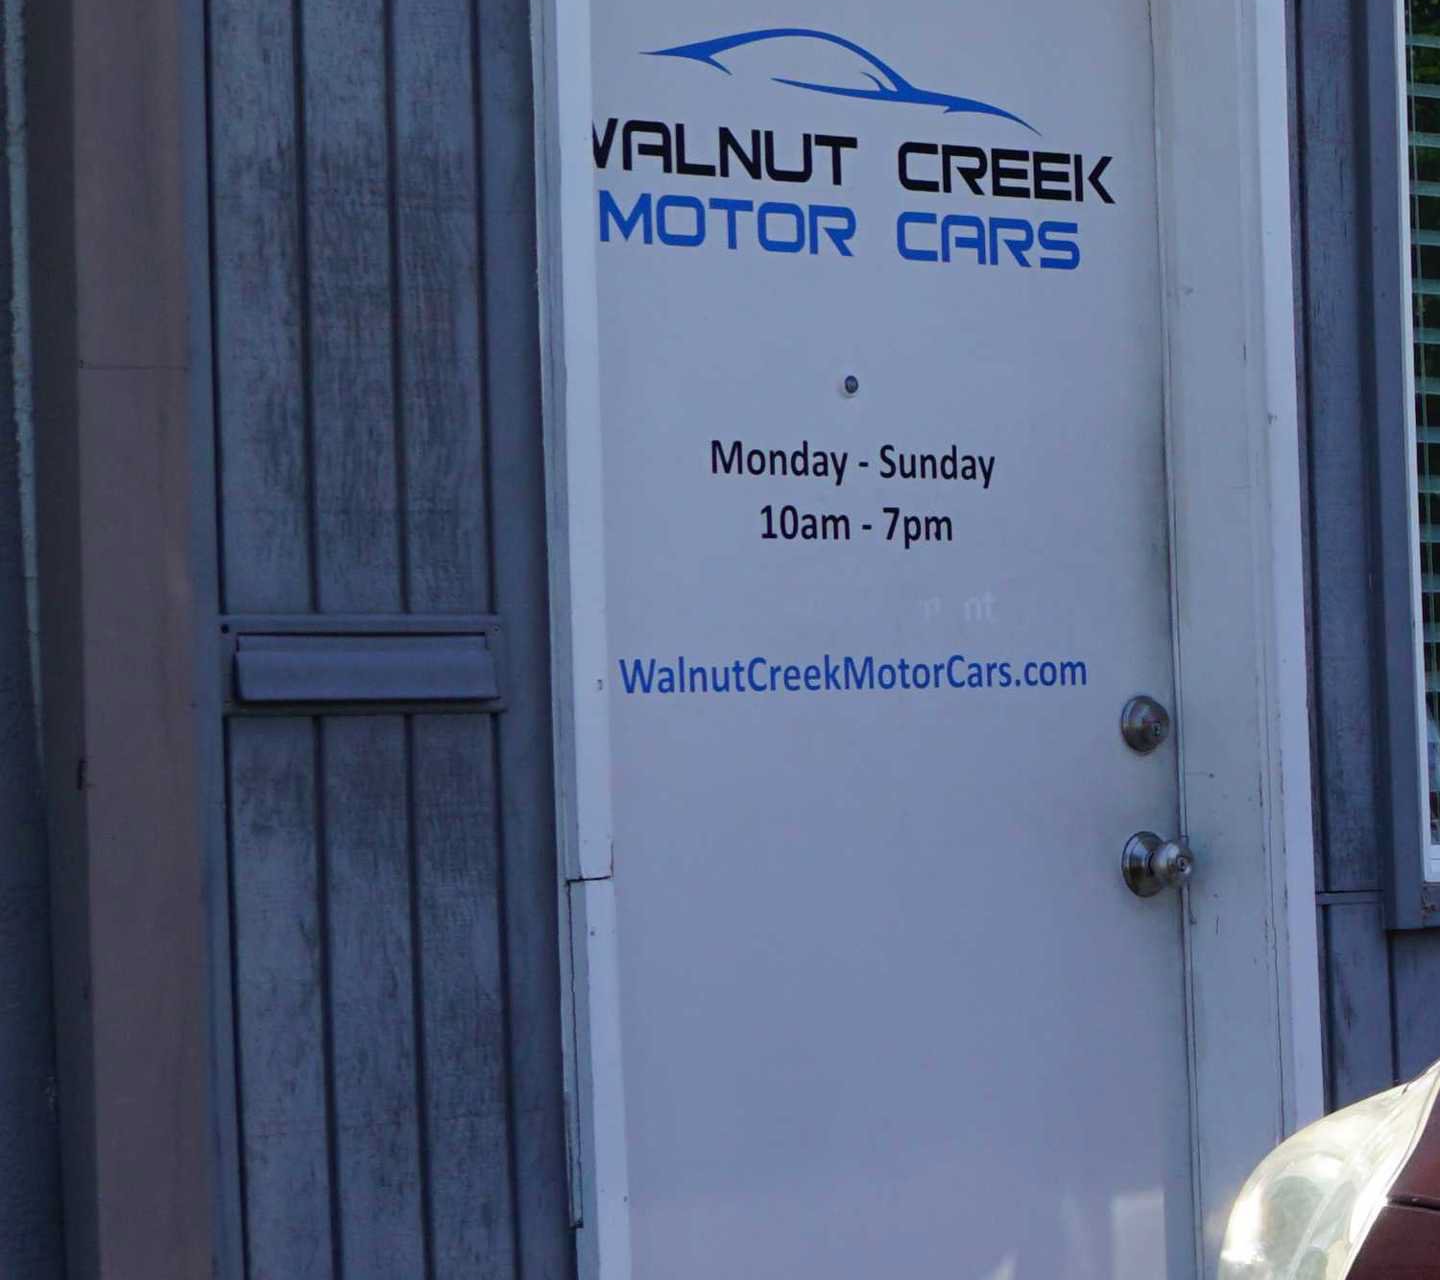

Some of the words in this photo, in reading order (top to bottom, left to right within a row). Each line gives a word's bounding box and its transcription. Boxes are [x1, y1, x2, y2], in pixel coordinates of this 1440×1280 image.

[897, 141, 1116, 204] CREEK
[598, 189, 856, 256] MOTOR
[897, 210, 1080, 270] CARS
[711, 440, 848, 486] Monday
[879, 445, 995, 488] Sunday
[760, 505, 850, 540] 10am
[882, 507, 953, 549] 7pm
[619, 654, 1087, 694] WalnutCreekMotorCars.com
